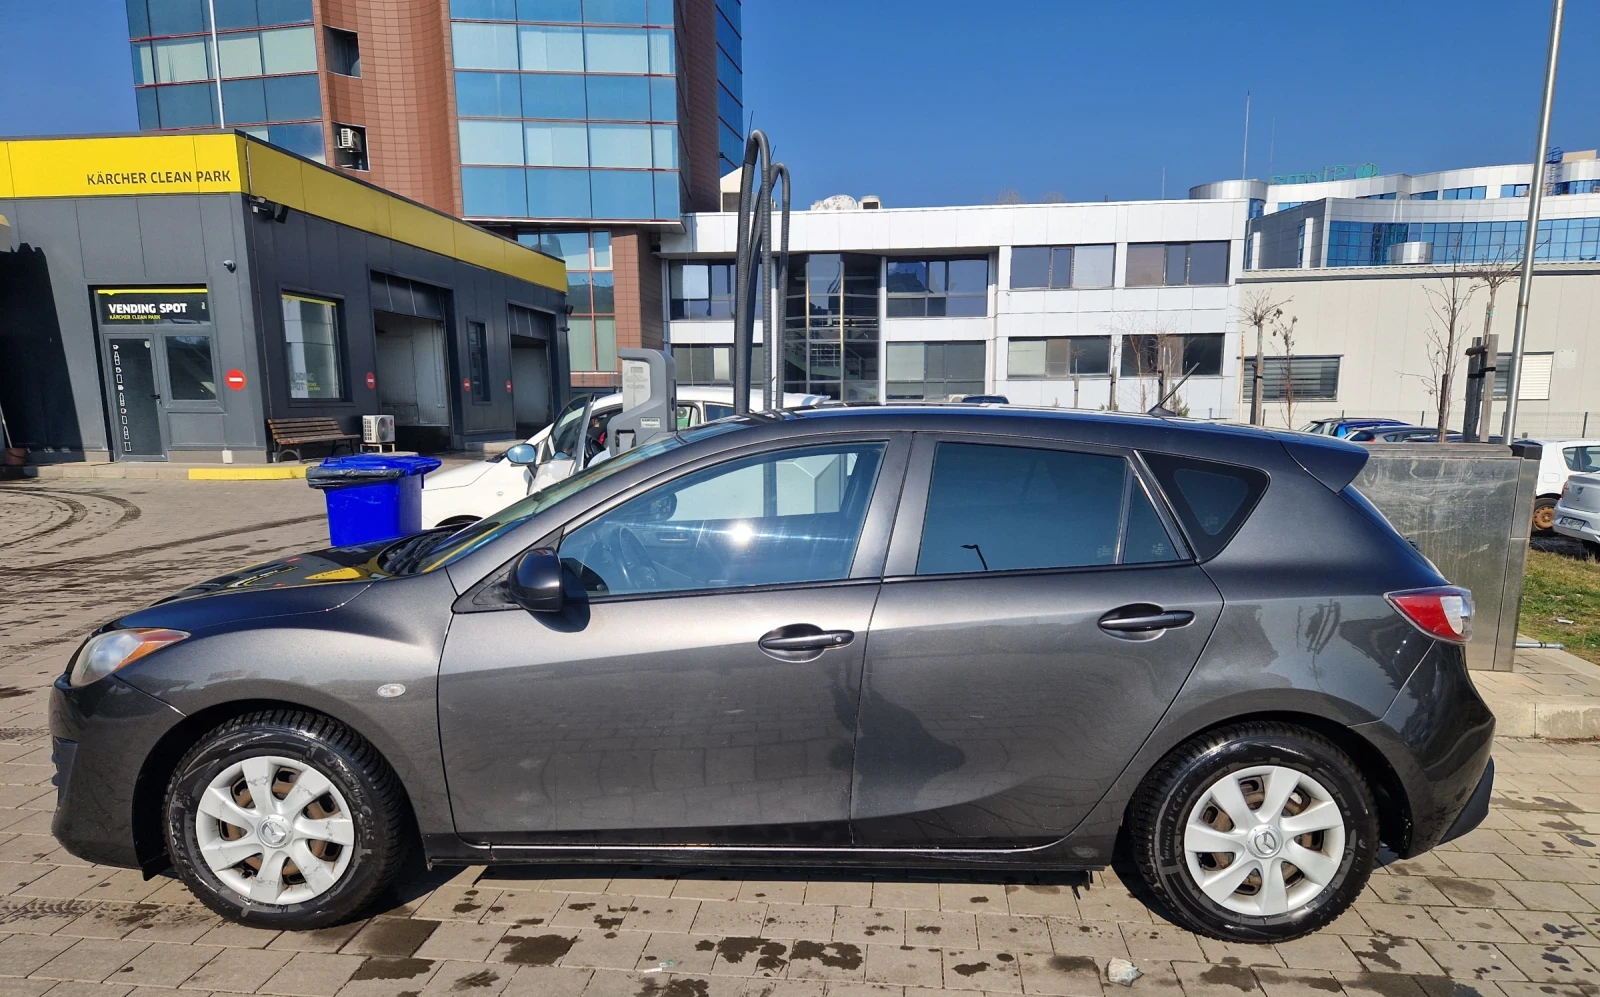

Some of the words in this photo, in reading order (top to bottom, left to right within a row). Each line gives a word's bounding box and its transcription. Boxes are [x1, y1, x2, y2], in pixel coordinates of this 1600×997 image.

[86, 171, 147, 186] KÄRCHER
[150, 171, 192, 184] CLEAN
[196, 170, 231, 183] PARK
[108, 303, 156, 313] VENDING
[160, 303, 188, 313] SPOT
